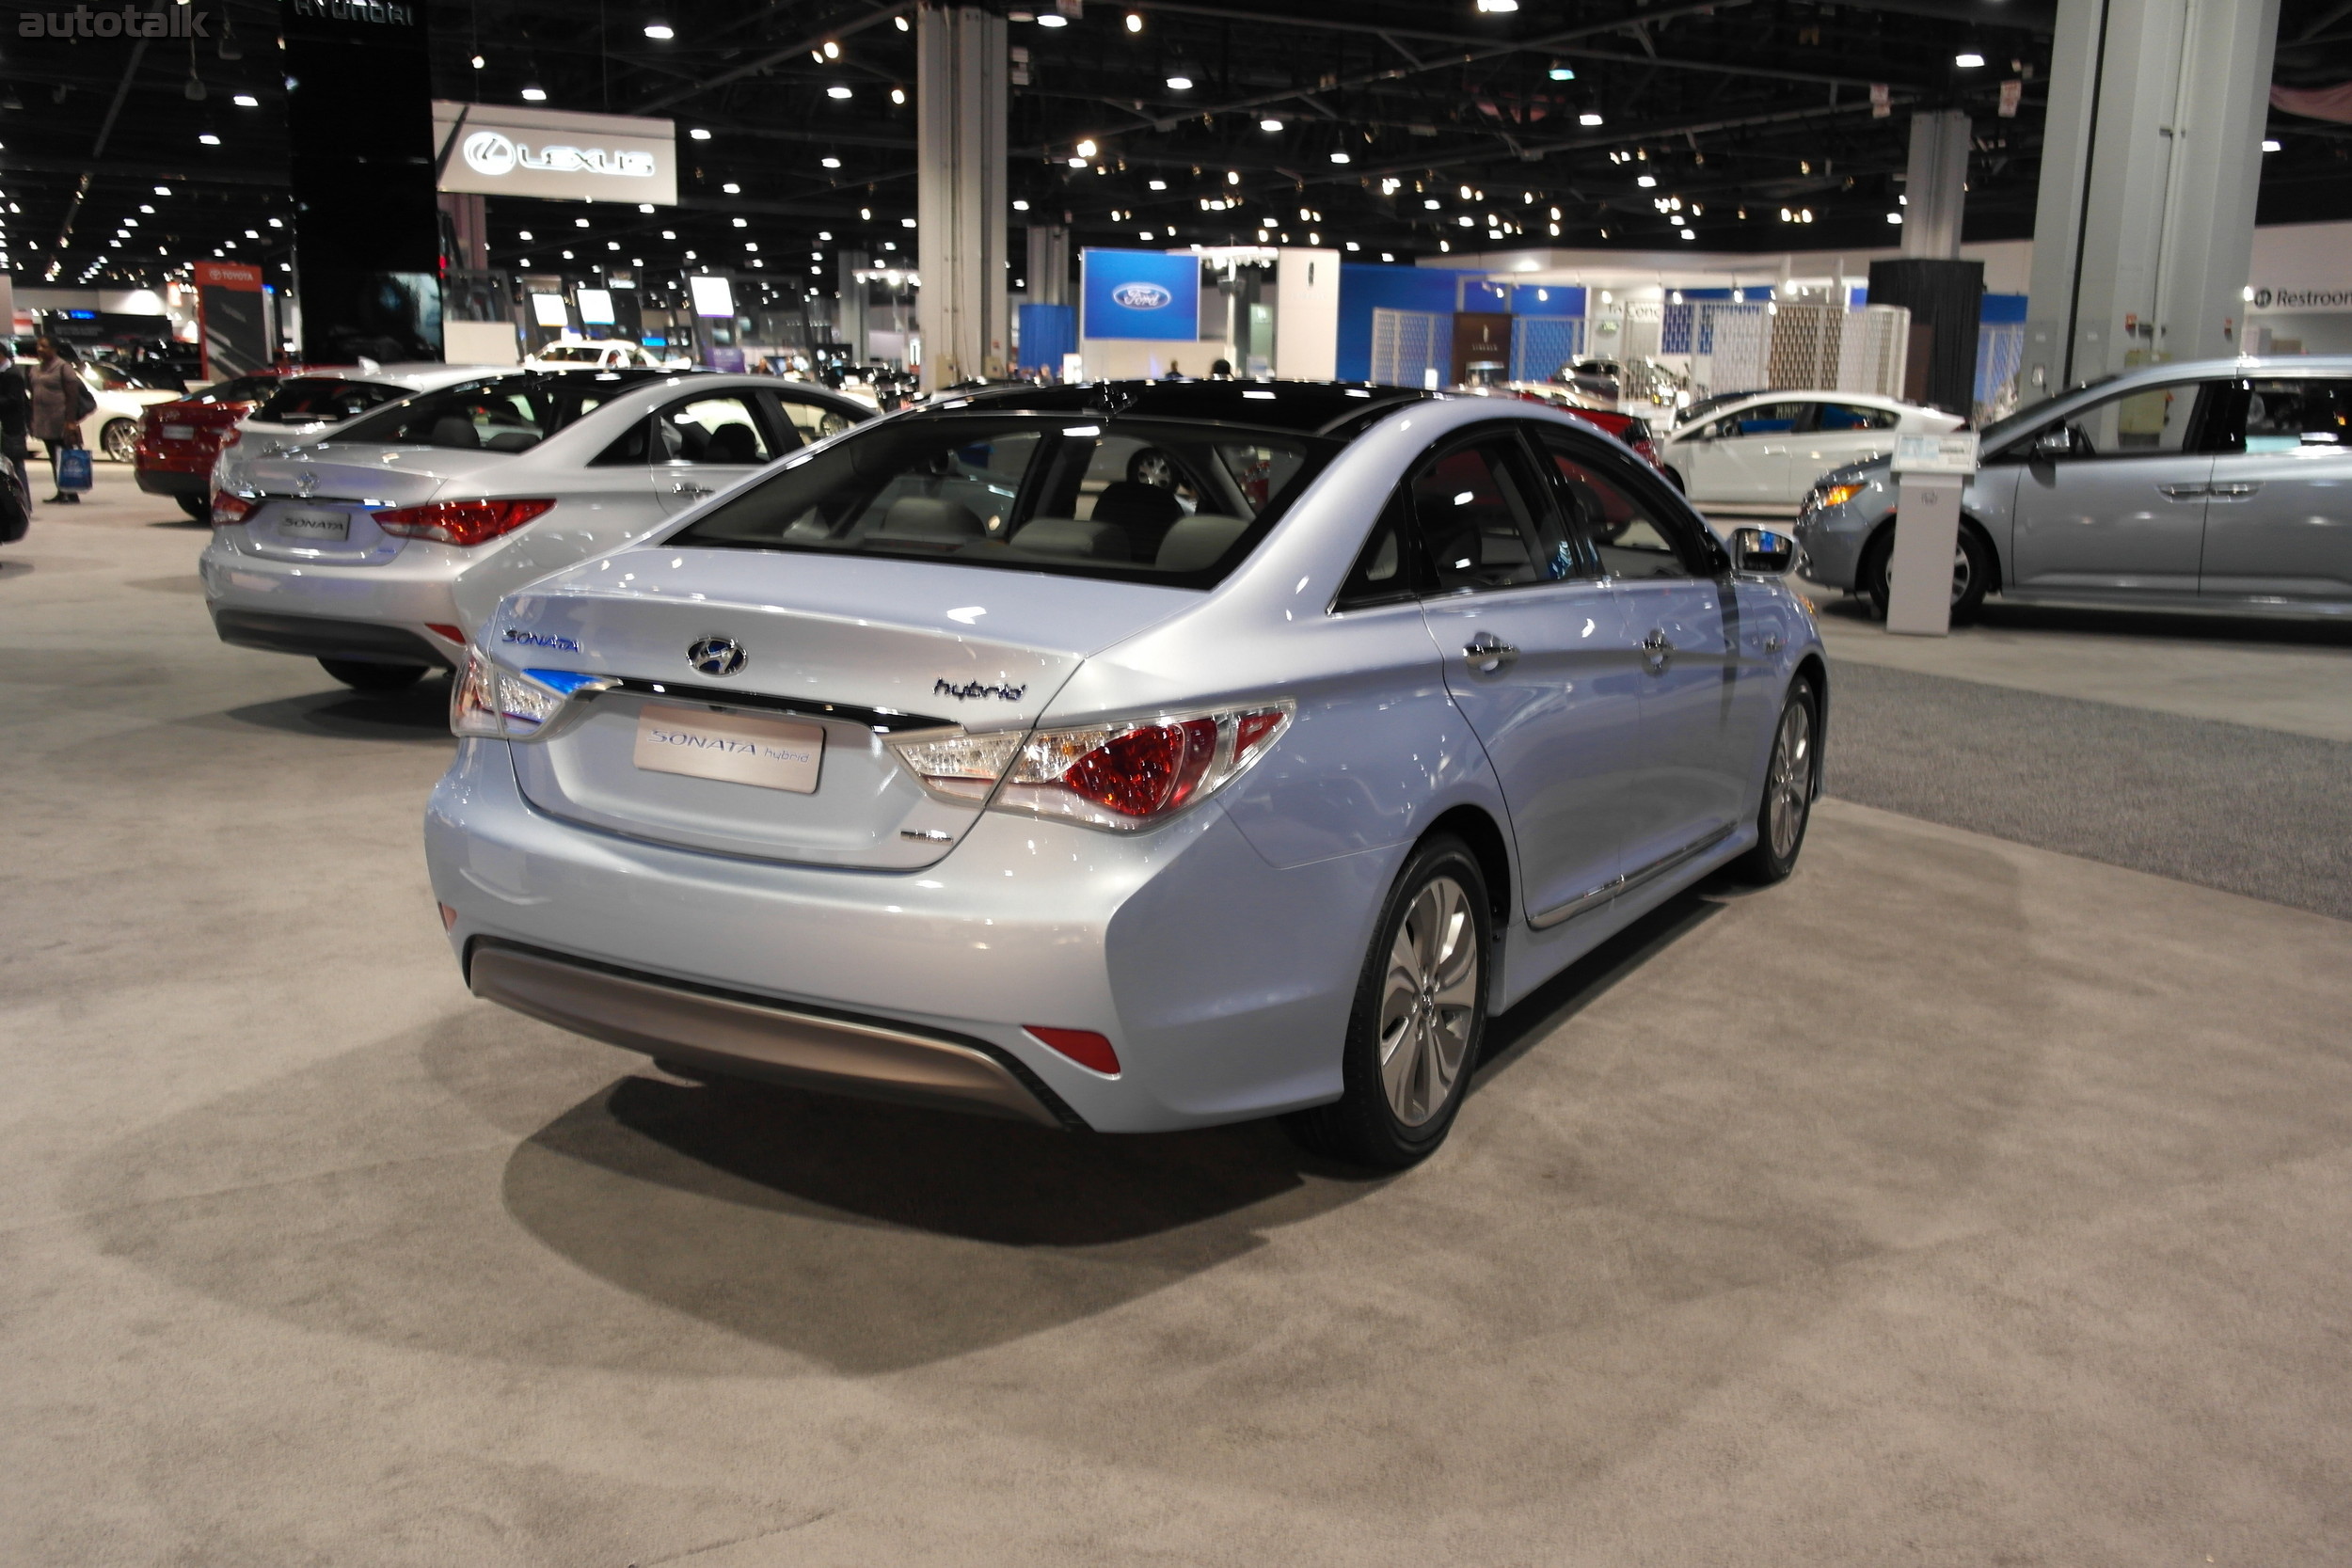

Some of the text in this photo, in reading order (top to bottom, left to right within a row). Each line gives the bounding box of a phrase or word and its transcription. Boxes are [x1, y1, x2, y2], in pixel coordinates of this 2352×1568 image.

[517, 143, 656, 178] LEXUS
[222, 269, 254, 281] TOYOTA
[1123, 285, 1160, 307] Ford
[284, 516, 345, 531] SONATA
[501, 629, 580, 654] SONATA
[932, 675, 1027, 702] hybrid
[648, 729, 810, 764] SONATA hybrid
